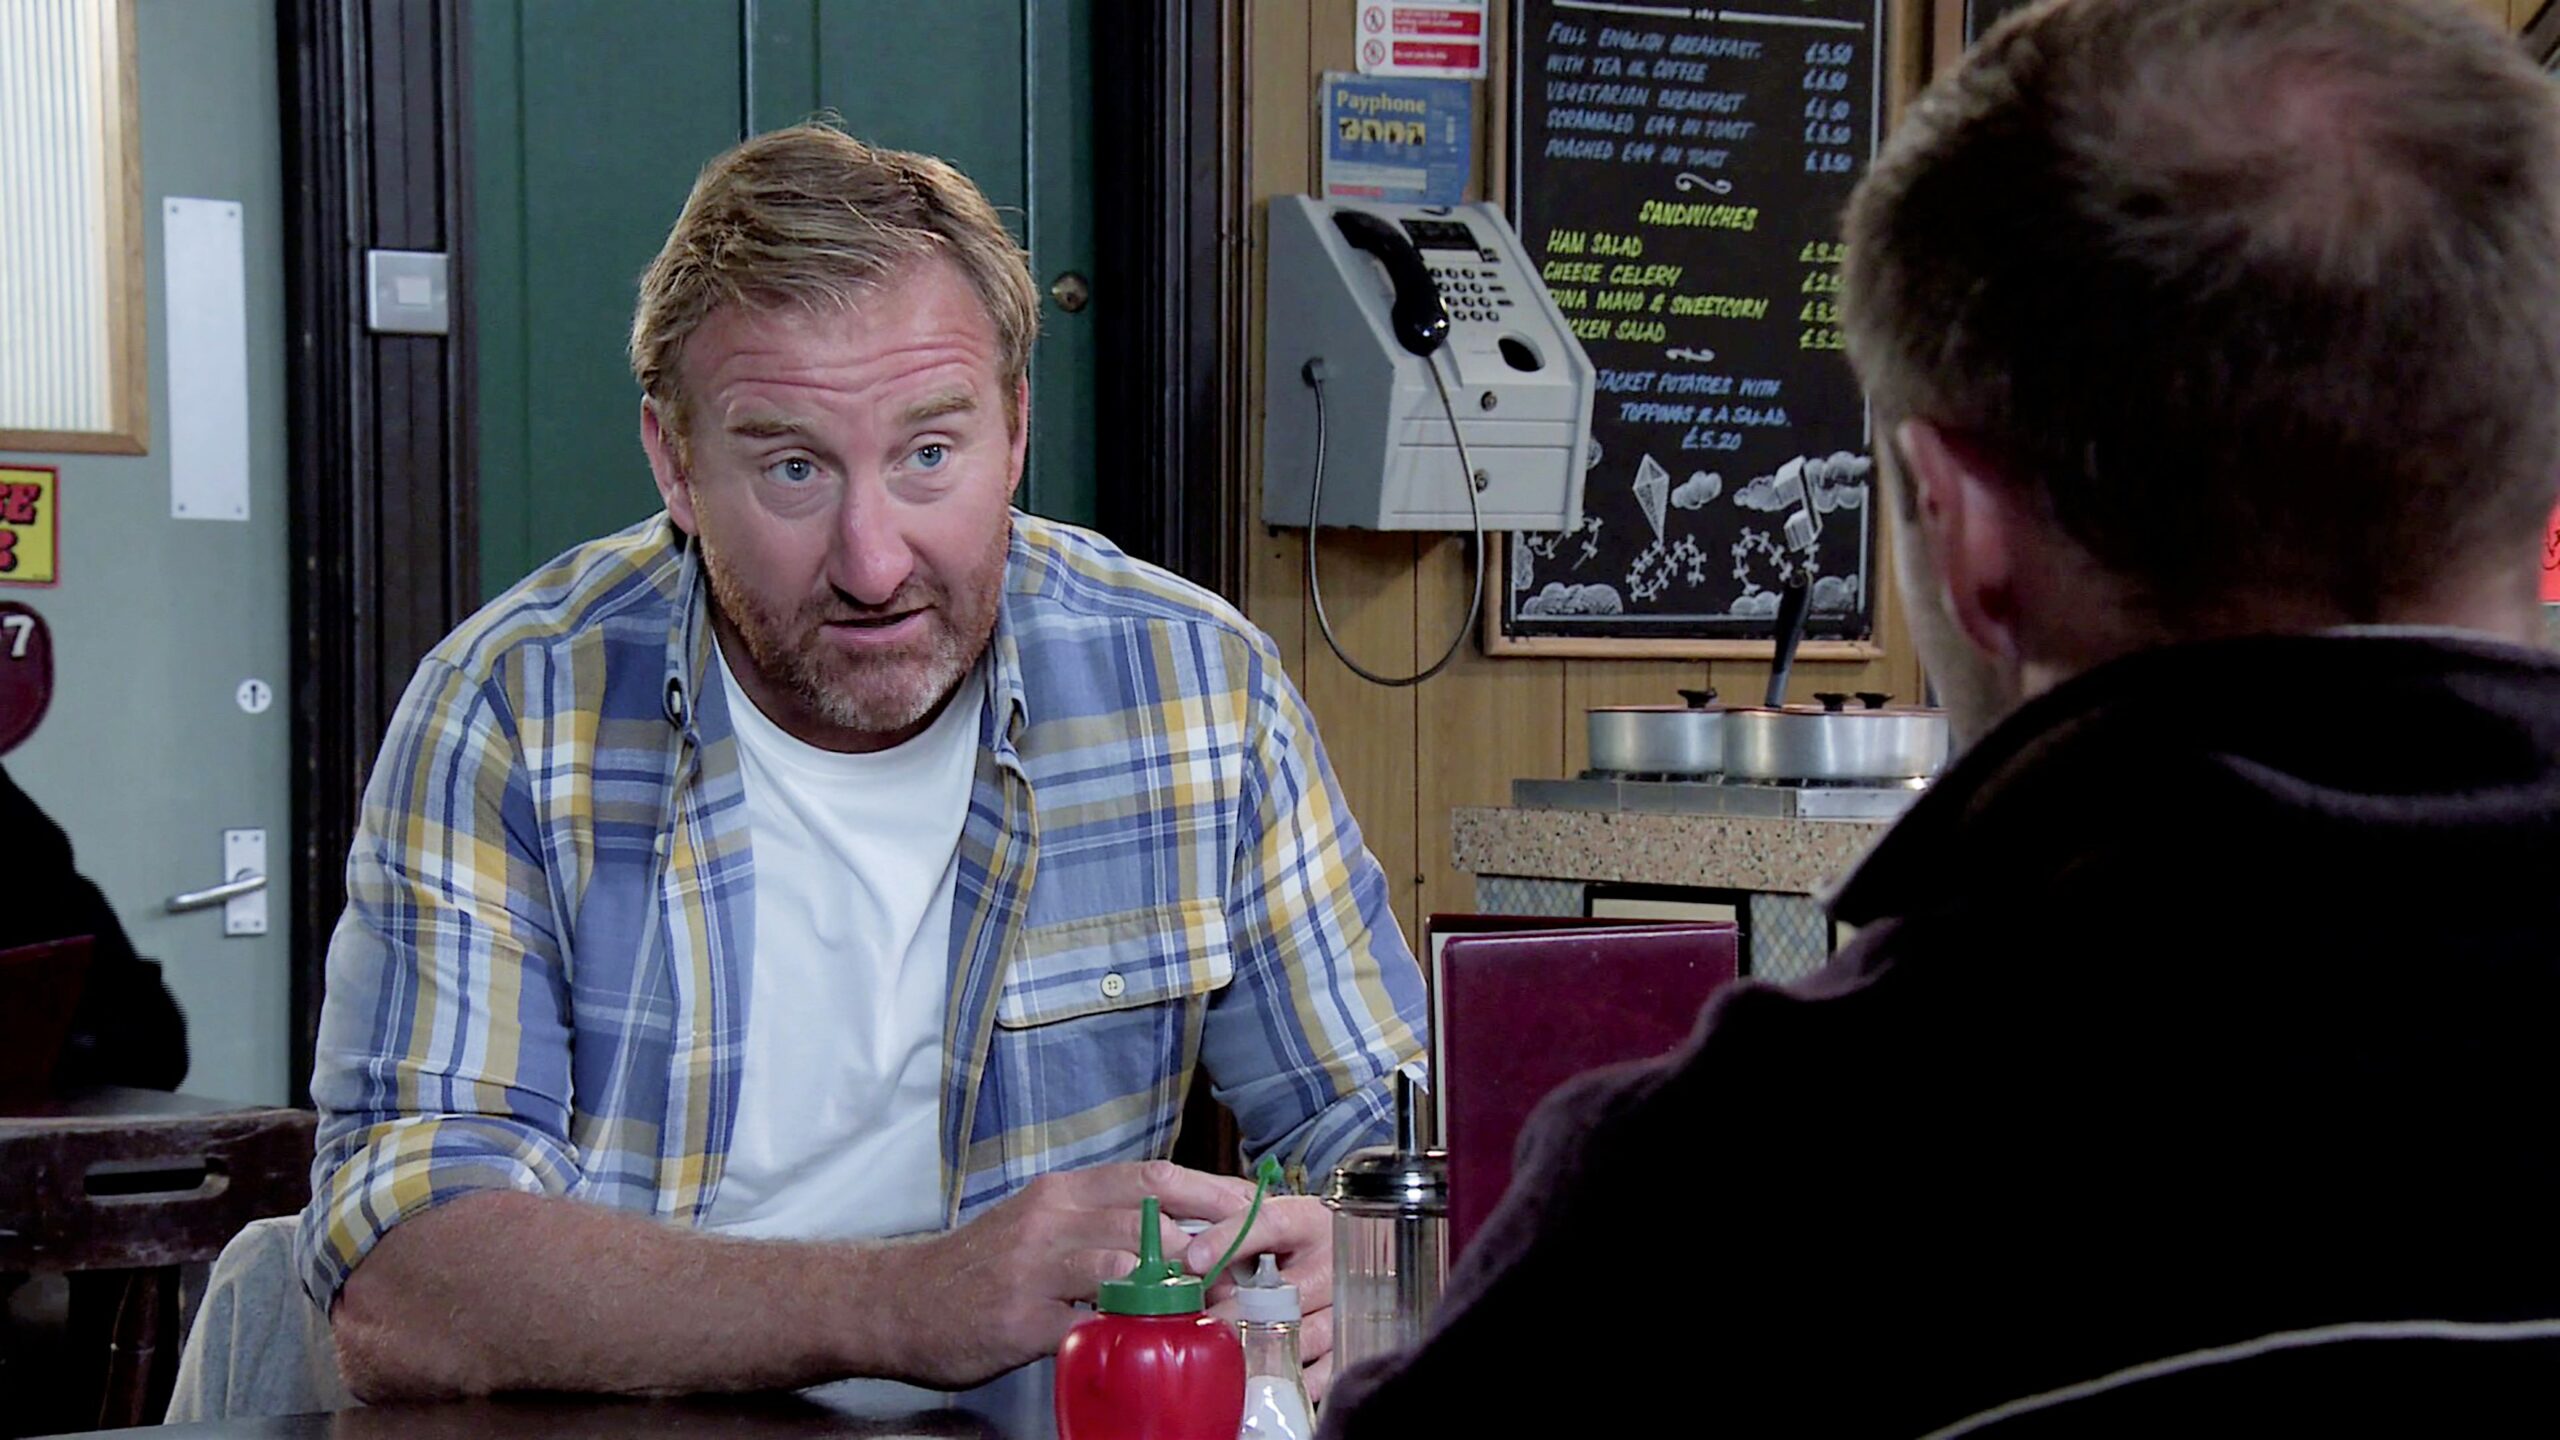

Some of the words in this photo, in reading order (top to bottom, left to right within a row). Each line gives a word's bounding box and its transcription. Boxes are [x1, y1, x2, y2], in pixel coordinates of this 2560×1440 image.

[1546, 21, 1587, 46] FULL
[1598, 27, 1666, 53] ENGLISH
[1546, 54, 1585, 74] WITH
[1592, 56, 1621, 77] TEA
[1651, 58, 1709, 83] COFFEE
[1337, 89, 1426, 116] Payphone
[1546, 80, 1651, 107] VEGETARIAN
[1657, 88, 1748, 113] BREAKFAST
[1546, 107, 1635, 134] SCRAMBLED
[1544, 138, 1615, 161] POACHED
[1638, 199, 1759, 232] SANDWICHES
[1546, 229, 1586, 254] HAM
[1590, 231, 1643, 258] SALAD
[1543, 260, 1604, 284] CHEESE
[1609, 264, 1684, 288] CELERY
[1595, 290, 1646, 312] MAYO
[1648, 292, 1666, 314] &
[1669, 294, 1769, 320] SWEETCORN
[1614, 319, 1667, 343] SALAD
[1596, 369, 1657, 393] JACKET
[1657, 372, 1733, 396] POTATOES
[1738, 376, 1782, 398] WITH
[1620, 401, 1695, 424] TOPPINGS
[1714, 404, 1730, 420] A
